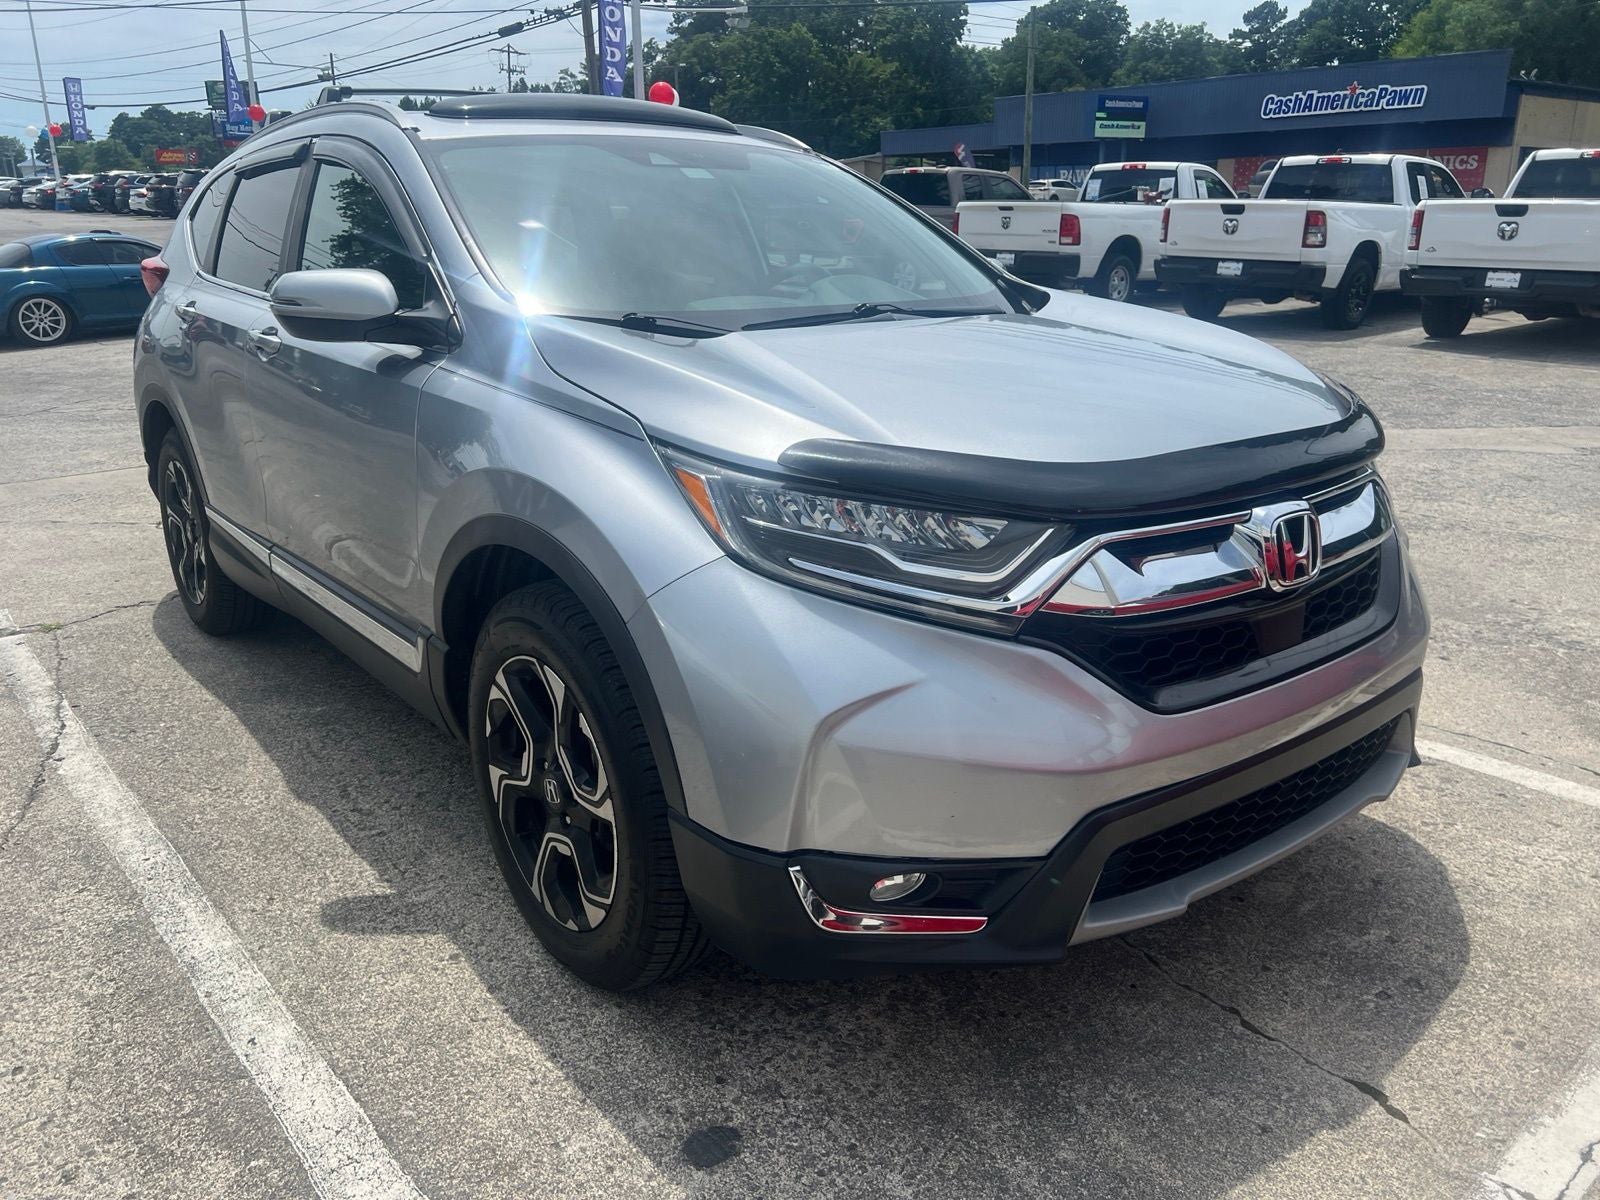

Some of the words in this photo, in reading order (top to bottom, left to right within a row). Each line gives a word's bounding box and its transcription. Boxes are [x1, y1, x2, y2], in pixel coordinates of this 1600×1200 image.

[604, 0, 624, 82] ONDA
[70, 95, 86, 133] HONDA
[1262, 83, 1426, 117] CashAmericaPawn
